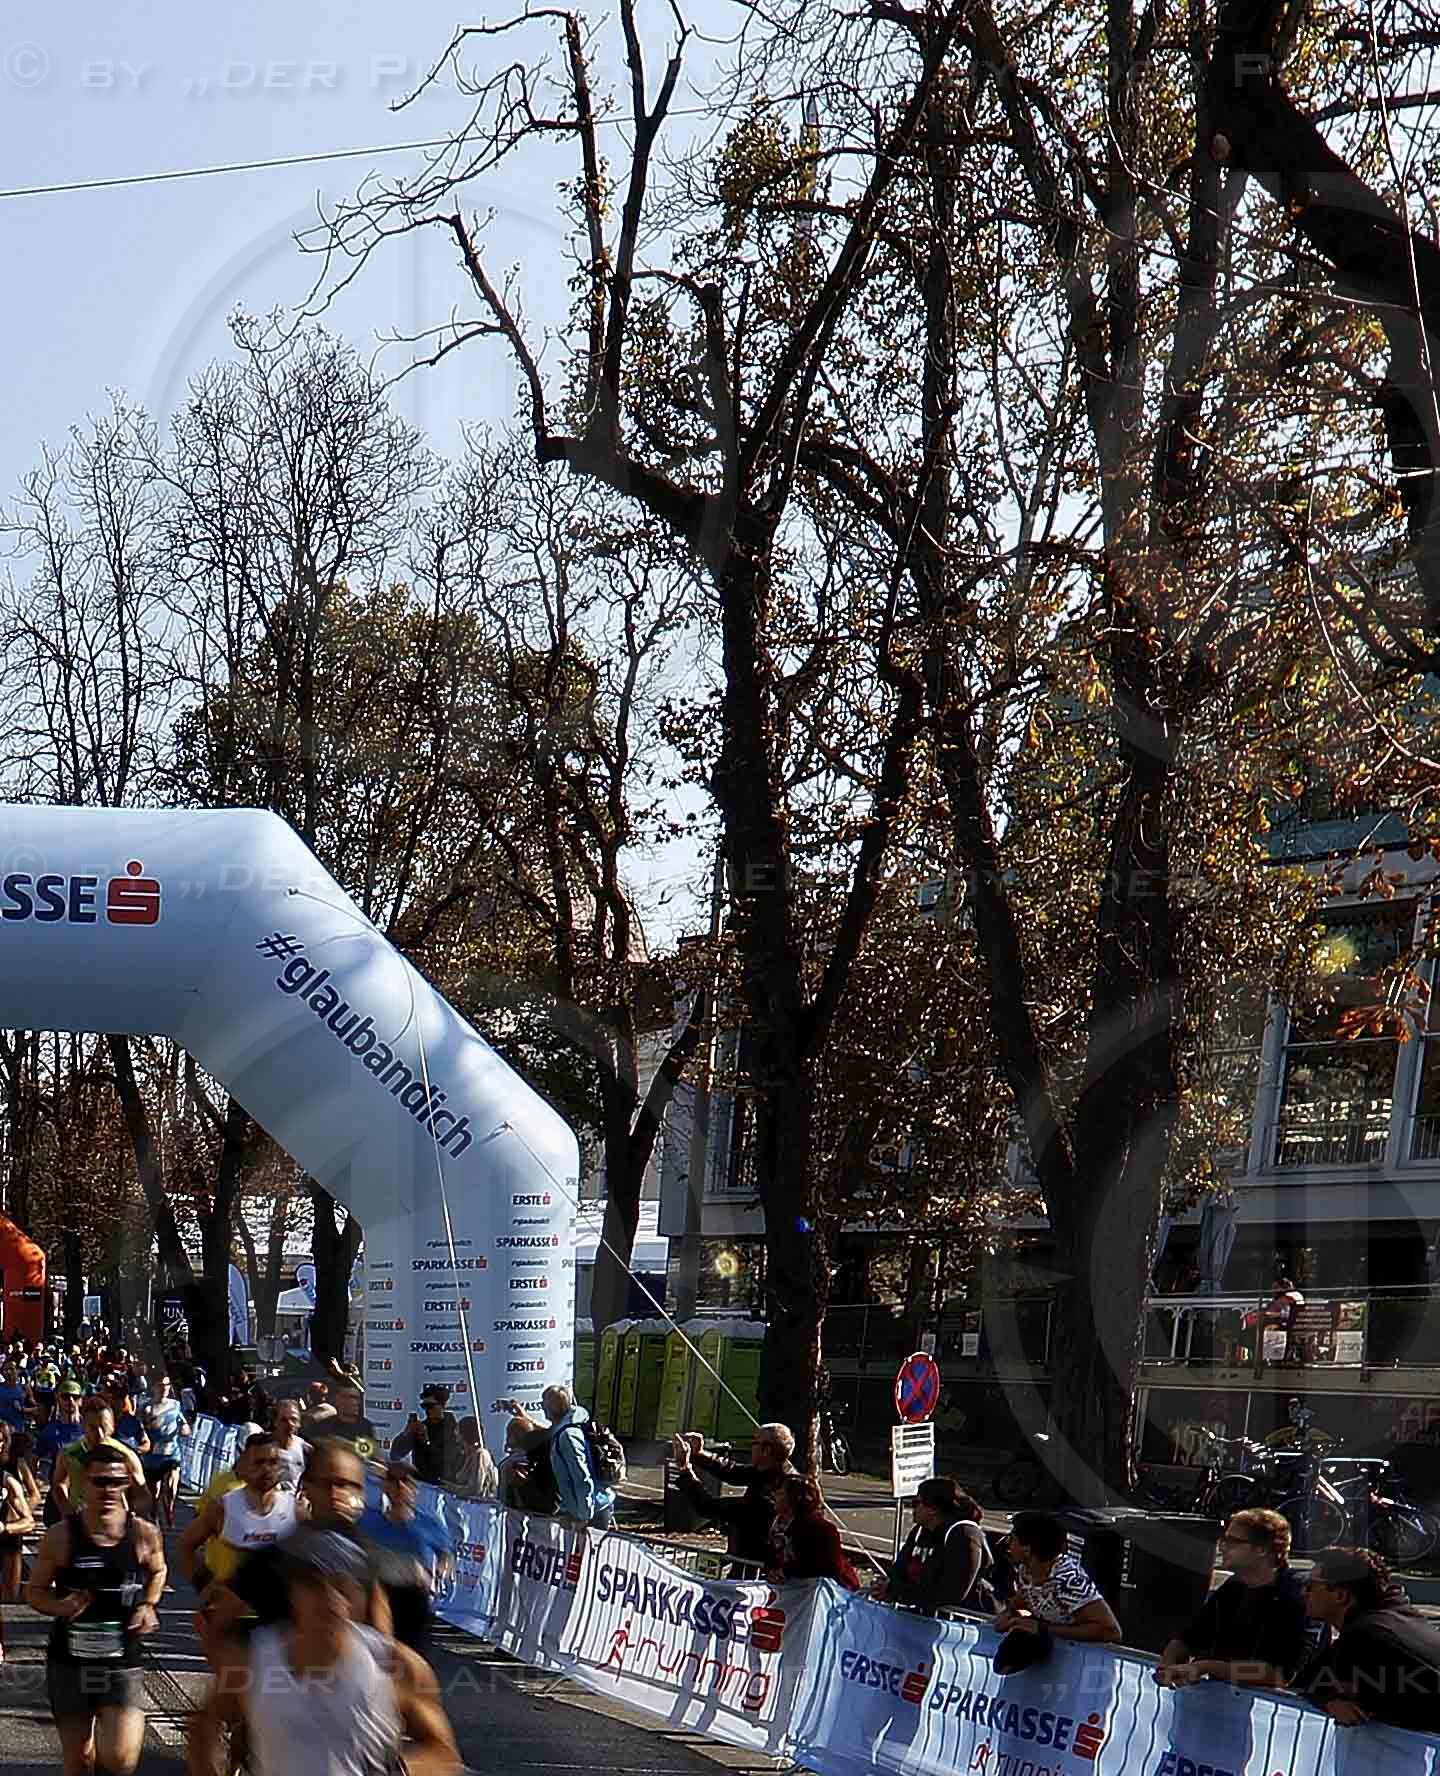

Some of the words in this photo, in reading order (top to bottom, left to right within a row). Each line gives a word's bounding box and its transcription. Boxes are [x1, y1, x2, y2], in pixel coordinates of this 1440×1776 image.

[256, 932, 474, 1159] #glaubandich
[512, 1195, 541, 1206] ERSTE
[496, 1236, 550, 1247] SPARKASSE
[509, 1279, 538, 1290] ERSTE
[424, 1301, 456, 1312] ERSTE
[493, 1319, 548, 1331] SPARKASSE
[507, 1361, 536, 1371] ERSTE
[512, 1538, 566, 1588] ERSTE
[597, 1563, 751, 1644] SPARKASSE
[639, 1634, 773, 1711] running
[840, 1648, 903, 1696] ERSTE
[930, 1681, 1075, 1752] SPARKASSE
